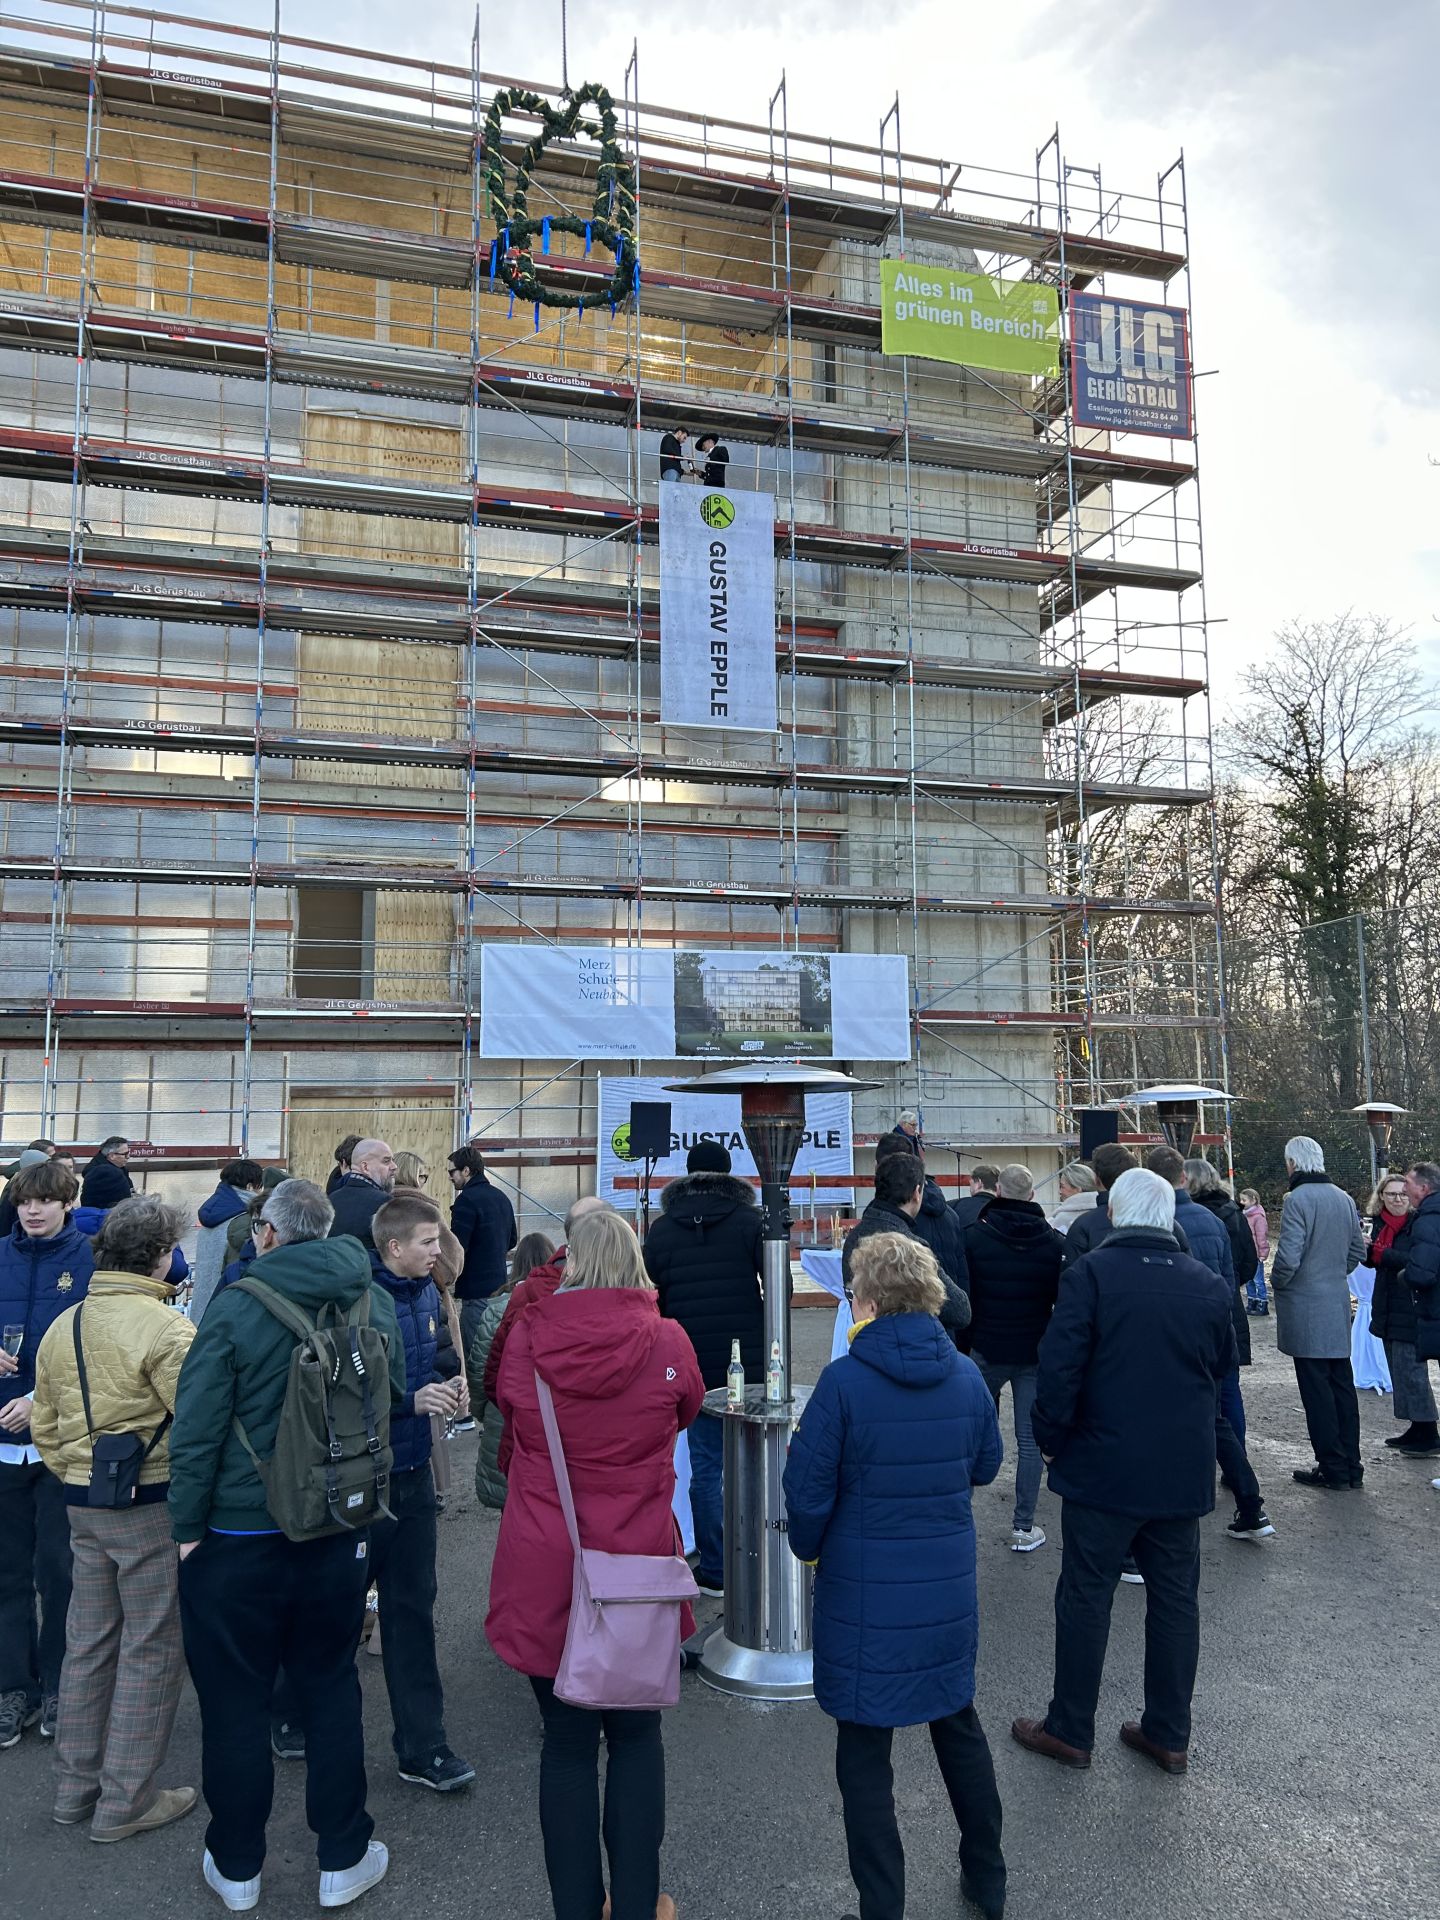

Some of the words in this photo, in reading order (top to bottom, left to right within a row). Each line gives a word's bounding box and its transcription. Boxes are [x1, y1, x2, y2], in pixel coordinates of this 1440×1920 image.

[150, 69, 170, 79] JLG
[172, 72, 222, 88] Gerüstbau
[894, 272, 943, 298] Alles
[950, 283, 973, 304] im
[895, 301, 964, 328] grünen
[971, 310, 1049, 340] Bereich.
[1085, 303, 1176, 384] JLG
[526, 371, 544, 381] JLG
[546, 374, 591, 388] Gerüstbau
[1087, 377, 1178, 410] GERÜSTBAU
[1088, 403, 1122, 415] Esslingen
[1150, 410, 1159, 420] 23
[1169, 413, 1179, 422] 40
[136, 451, 157, 461] JLG
[159, 453, 212, 467] Gerüstbau
[963, 544, 978, 553] JLG
[980, 545, 1018, 557] Gerüstbau
[131, 583, 152, 593] JLG
[154, 585, 206, 598] Gerüstbau
[709, 541, 728, 634] GUSTAV
[710, 641, 728, 717] EPPLE
[124, 719, 146, 729] JLG
[148, 721, 201, 732] Gerüstbau
[686, 880, 704, 888] JLG
[706, 880, 749, 891] Gerüstbau
[1122, 899, 1138, 907] JLG
[579, 958, 611, 970] Merz
[578, 972, 620, 985] Schule
[579, 988, 624, 1000] Neubau
[133, 1001, 158, 1011] Layher
[324, 1000, 345, 1009] JLG
[128, 1147, 155, 1157] Layher
